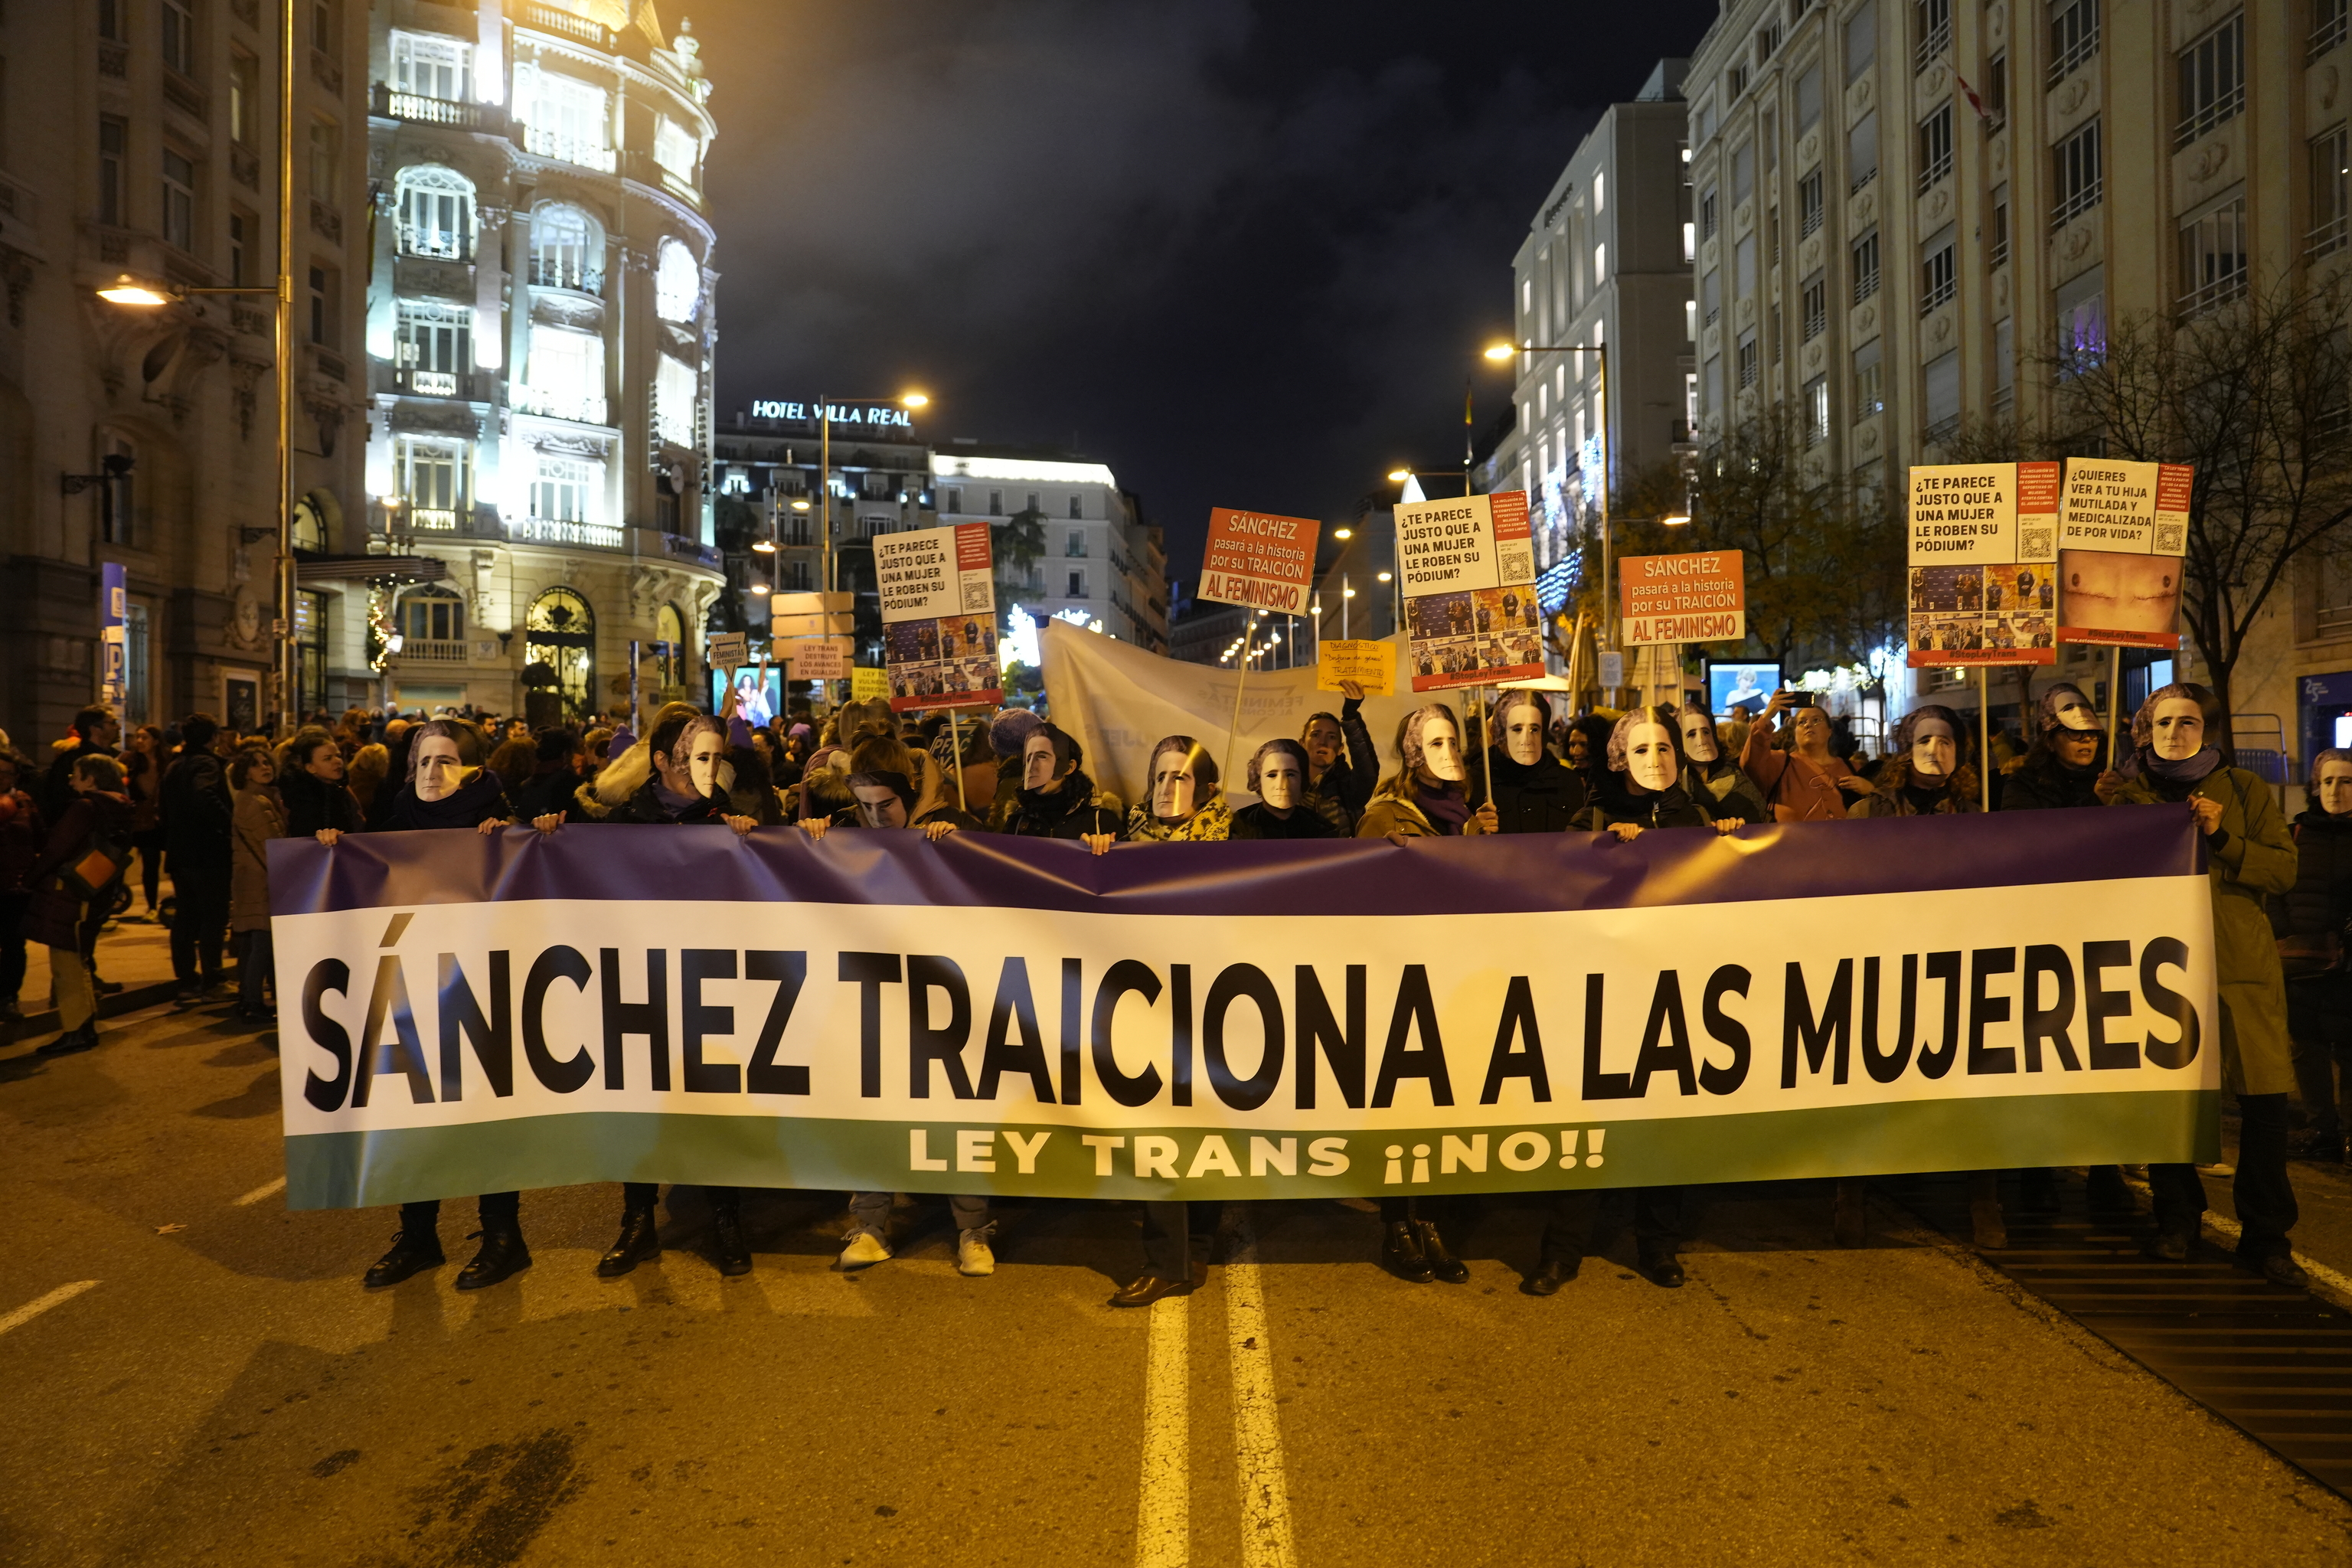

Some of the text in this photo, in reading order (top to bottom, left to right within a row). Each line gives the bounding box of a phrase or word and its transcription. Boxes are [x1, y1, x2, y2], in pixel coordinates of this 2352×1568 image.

[752, 400, 912, 426] HOTEL VILLA REAL
[2072, 469, 2126, 482] ¿QUIERES
[1916, 476, 1996, 492] ¿TE PARECE
[2071, 483, 2147, 498] VER A TU HIJA
[1916, 492, 2003, 506] JUSTO QUE A
[2069, 498, 2138, 511] MUTILADA Y
[1401, 508, 1472, 528] ¿TE PARECE
[1916, 508, 1994, 521] UNA MUJER
[2068, 511, 2151, 527] MEDICALIZADA
[1228, 511, 1298, 540] SÁNCHEZ
[1403, 522, 1481, 541] JUSTO QUE A
[1916, 524, 1998, 537] LE ROBEN SU
[2066, 526, 2142, 540] DE POR VIDA?
[878, 539, 939, 558] ¿TE PARECE
[1214, 538, 1246, 552] pasará
[1255, 541, 1264, 555] la
[1266, 543, 1305, 561] historia
[1404, 537, 1475, 555] UNA MUJER
[1916, 538, 1975, 552] PÓDIUM?
[880, 552, 946, 570] JUSTO QUE A
[1210, 554, 1304, 579] por su TRAICIÓN
[1406, 551, 1480, 570] LE ROBEN SU
[1644, 556, 1720, 577] SÁNCHEZ
[881, 567, 941, 583] UNA MUJER
[1407, 568, 1460, 583] PÓDIUM?
[883, 581, 945, 597] LE ROBEN SU
[1206, 573, 1299, 610] AL FEMINISMO
[1632, 577, 1734, 599] pasará a la historia
[884, 596, 929, 610] PÓDIUM?
[1631, 590, 1736, 616] por su TRAICIÓN
[1632, 613, 1736, 642] AL FEMINISMO
[2087, 629, 2147, 640] #StopLeyTrans
[713, 648, 744, 659] FEMINISTAS
[1949, 650, 2017, 660] #StopLeyTrans
[1450, 668, 1511, 681] #StopLeyTrans
[302, 913, 2201, 1112] SÁNCHEZ TRAICIONA A LAS MUJERES
[910, 1129, 1606, 1184] LEY TRANS ¡¡NO!!
